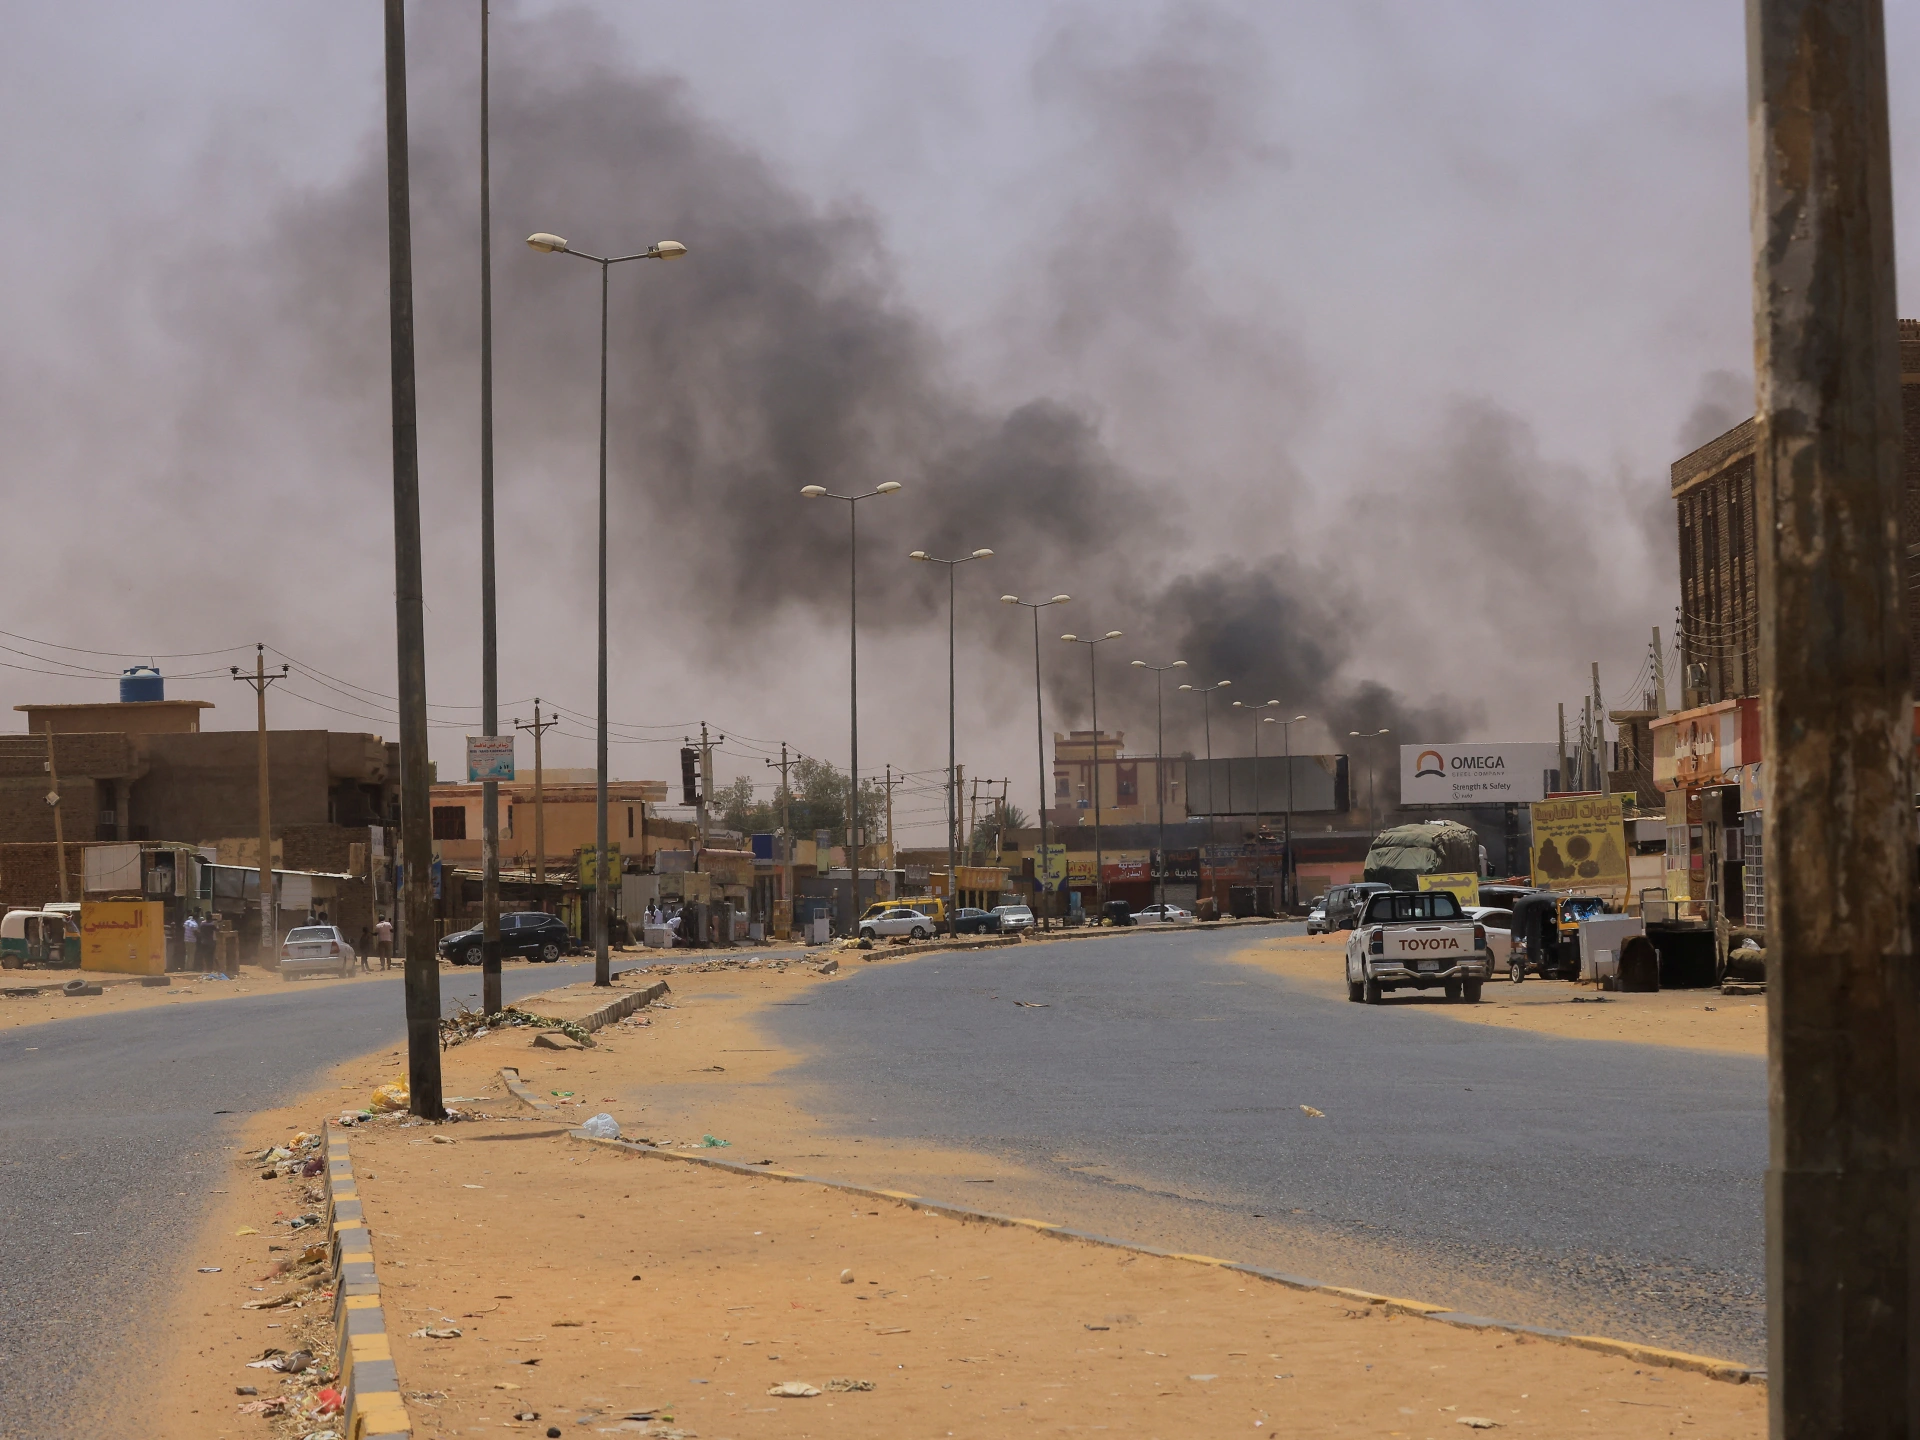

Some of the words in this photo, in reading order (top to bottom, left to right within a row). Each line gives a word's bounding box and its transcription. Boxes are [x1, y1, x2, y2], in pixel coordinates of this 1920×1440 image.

[1451, 756, 1505, 769] OMEGA
[1452, 783, 1481, 792] Strength
[1489, 782, 1511, 791] Safety
[1534, 803, 1578, 824] الشامية
[1580, 801, 1621, 820] حلويات
[1174, 868, 1199, 879] جلابية
[1398, 938, 1459, 951] TOYOTA
